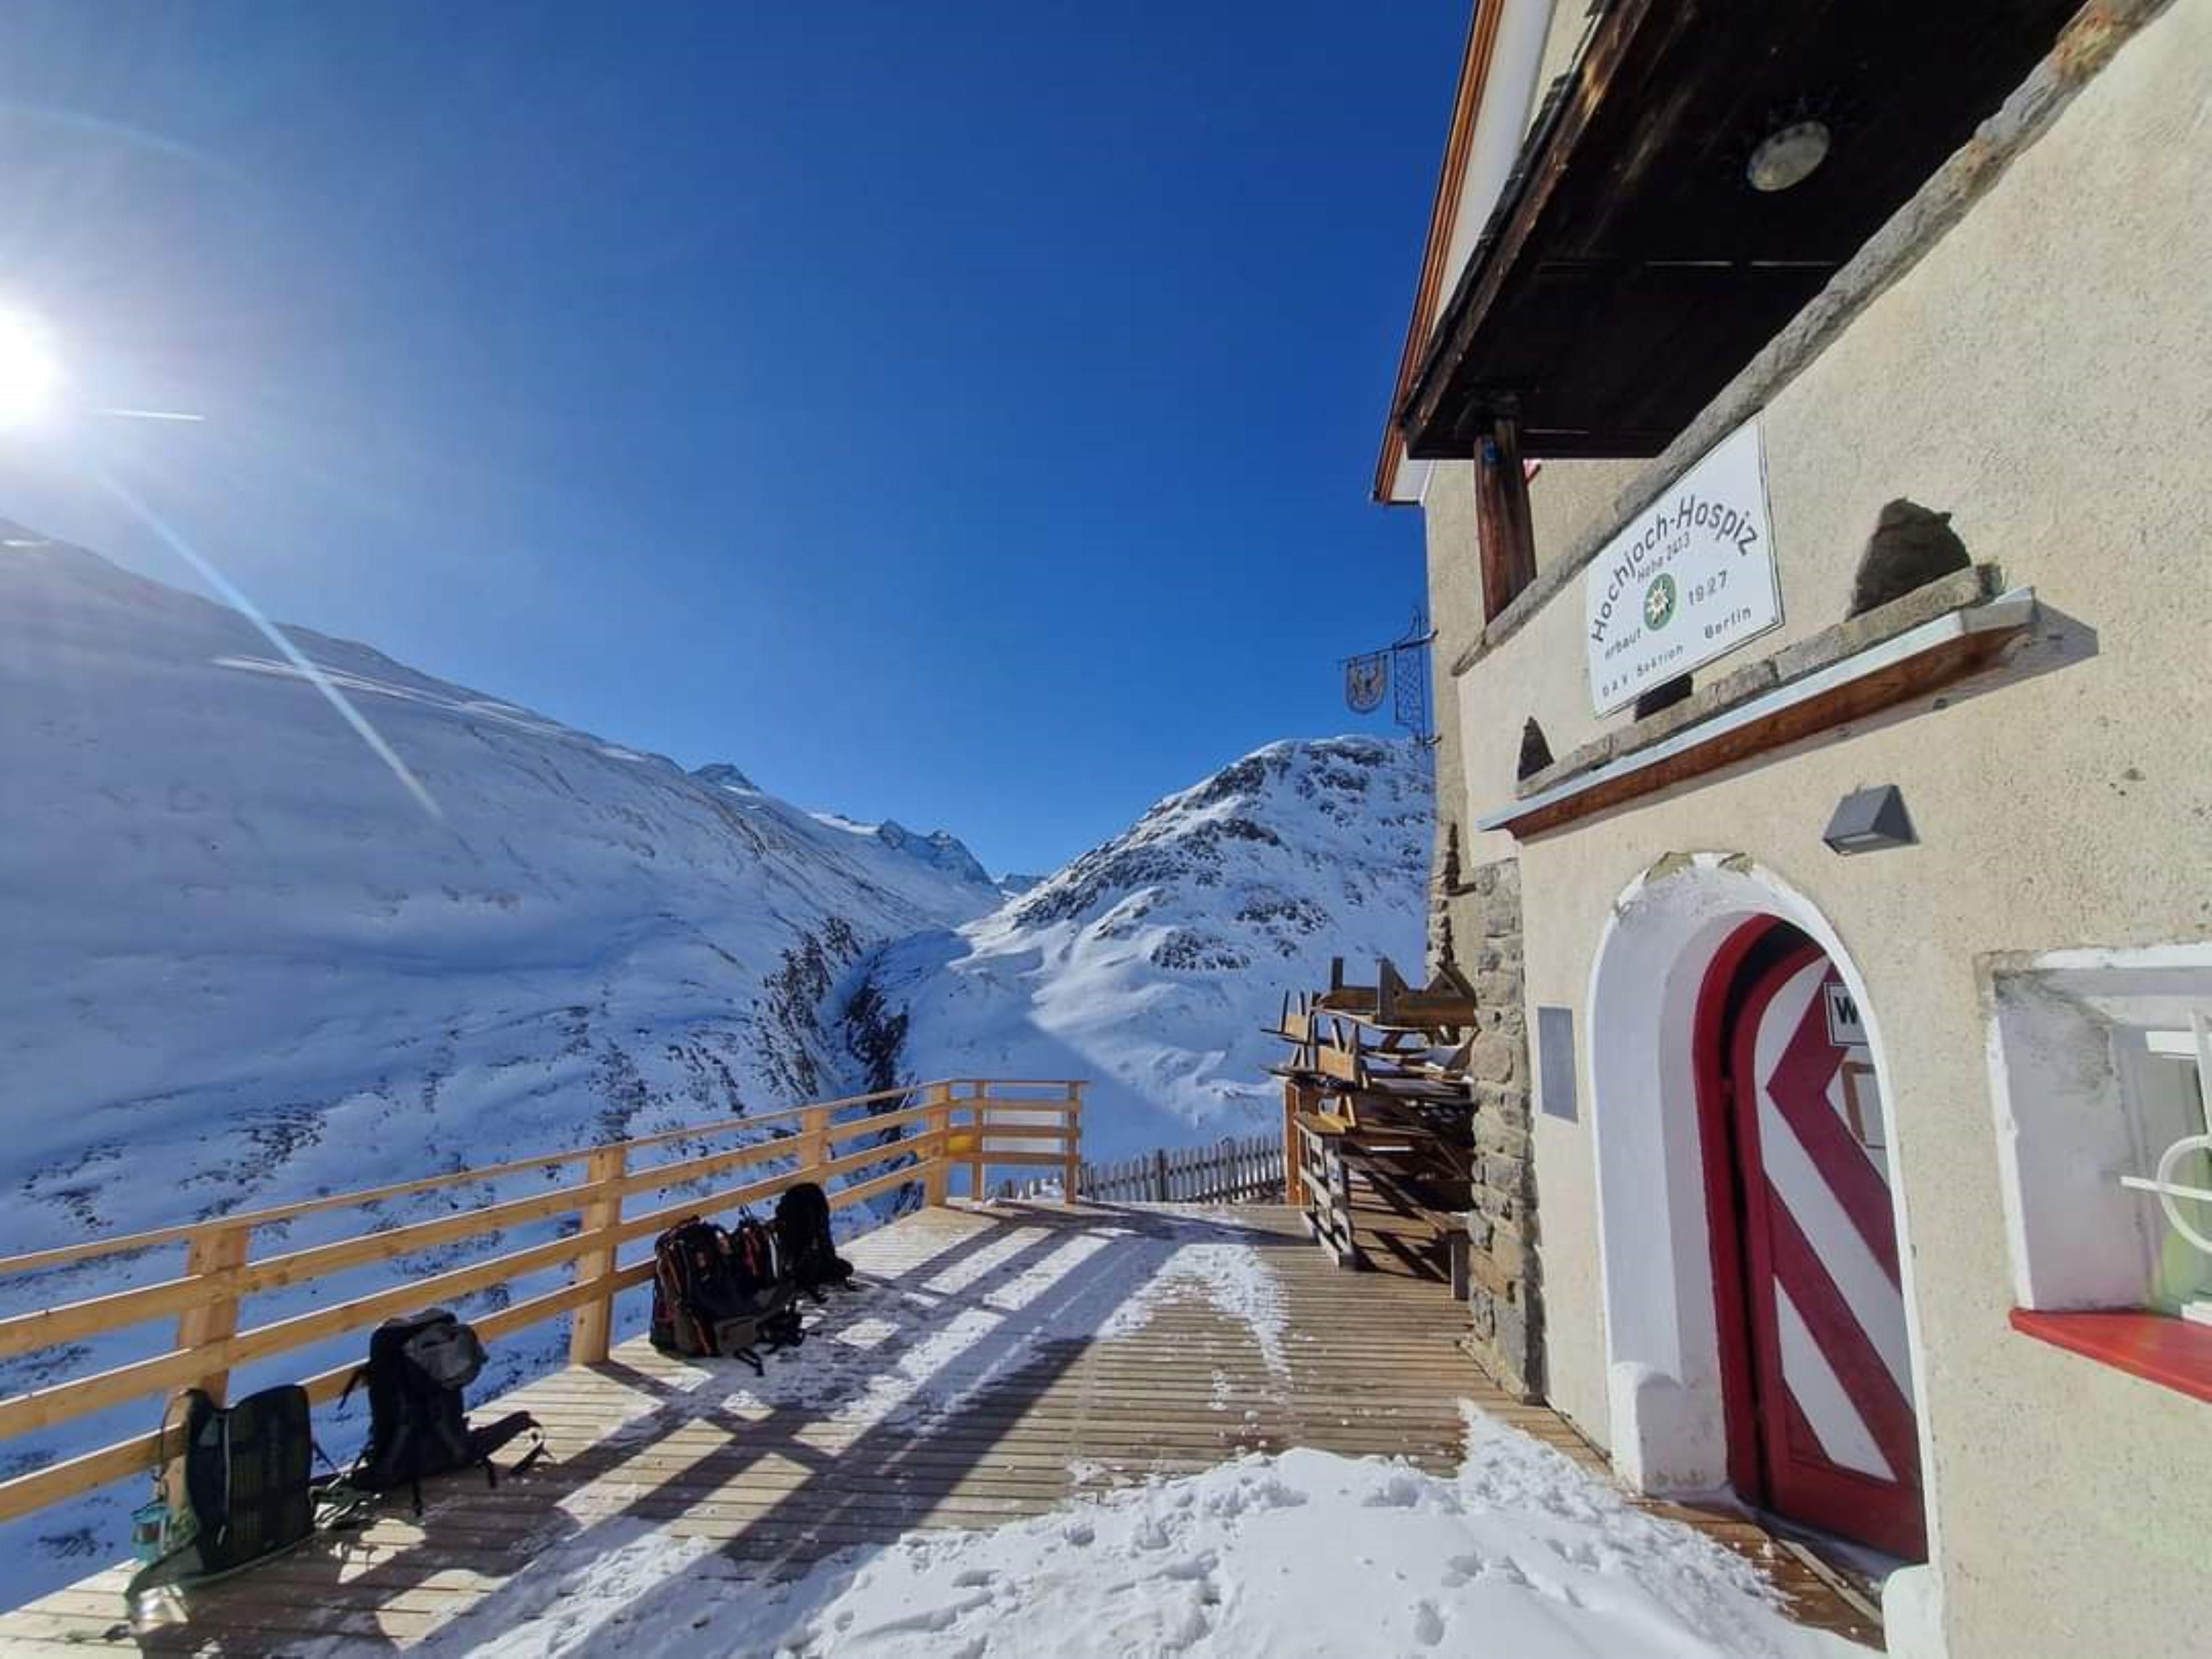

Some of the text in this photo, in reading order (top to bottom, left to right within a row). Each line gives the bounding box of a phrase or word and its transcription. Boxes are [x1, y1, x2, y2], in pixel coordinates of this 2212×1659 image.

[1590, 494, 1758, 642] Hochjoch-Hospiz
[1605, 570, 1726, 659] erbaut 1927
[1637, 644, 1684, 677] Sektion
[1704, 607, 1751, 639] Berlin
